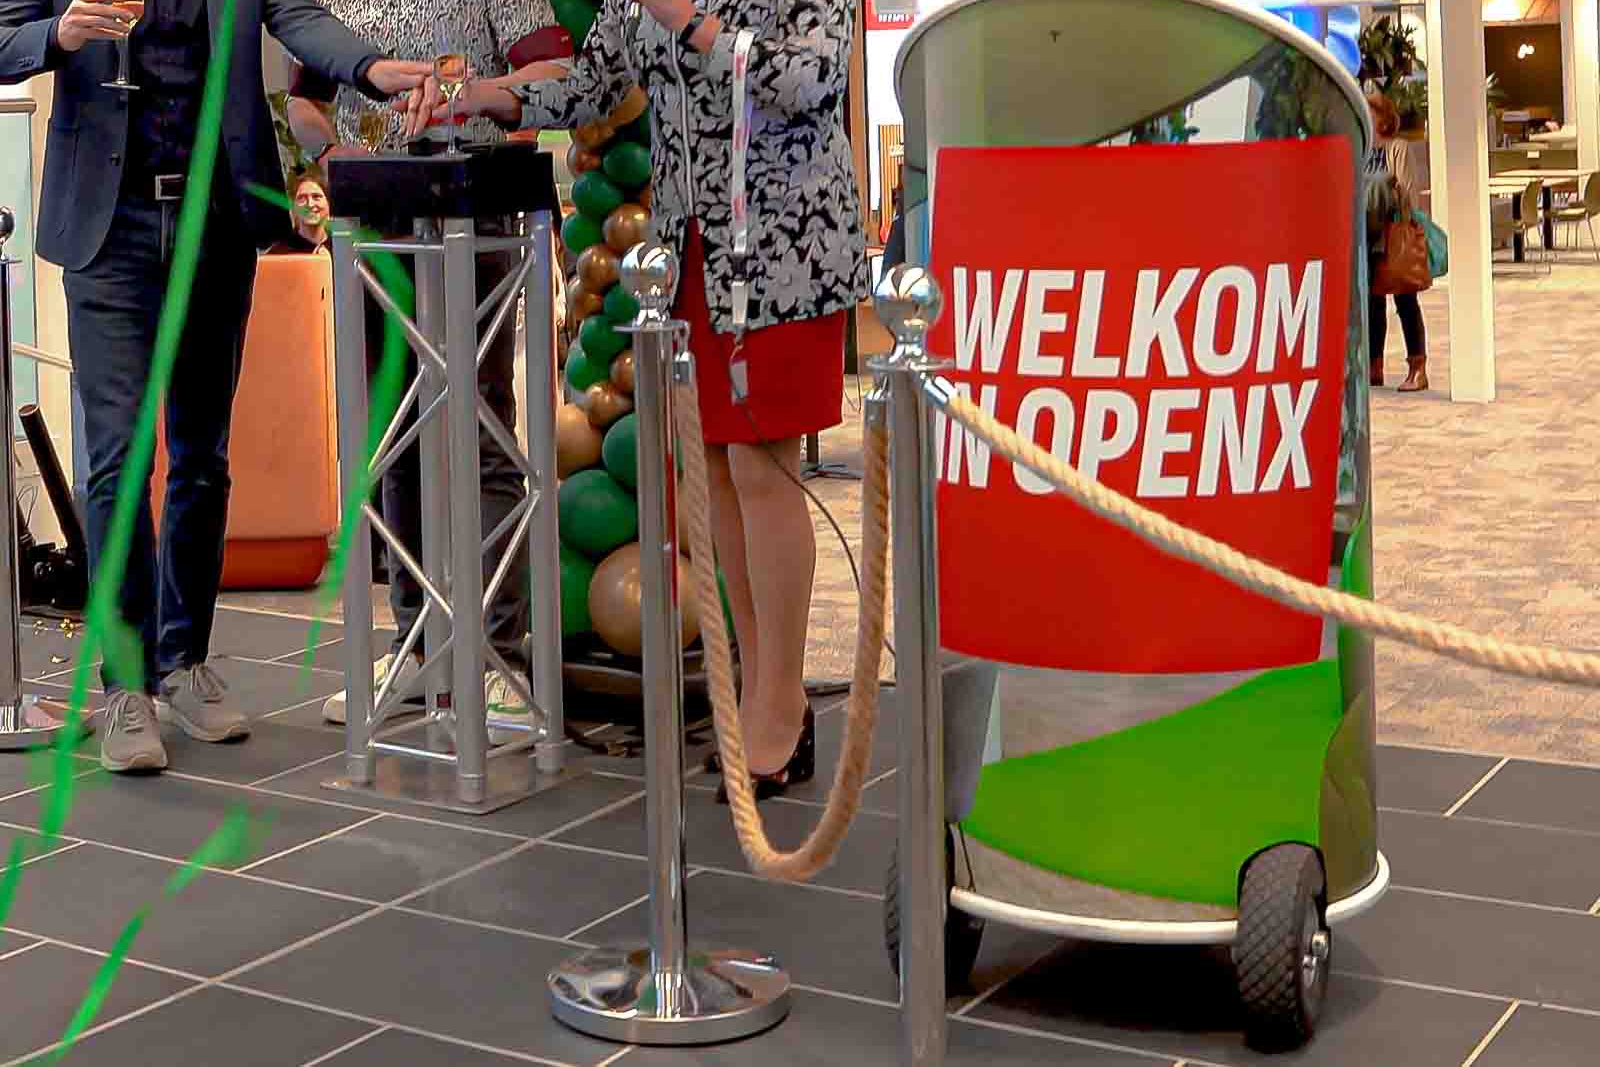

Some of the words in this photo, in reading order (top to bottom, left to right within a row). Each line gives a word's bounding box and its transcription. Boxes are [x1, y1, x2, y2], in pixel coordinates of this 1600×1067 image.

[952, 259, 1323, 378] WELKOM
[934, 380, 998, 489] IN
[1012, 378, 1320, 499] OPENX
